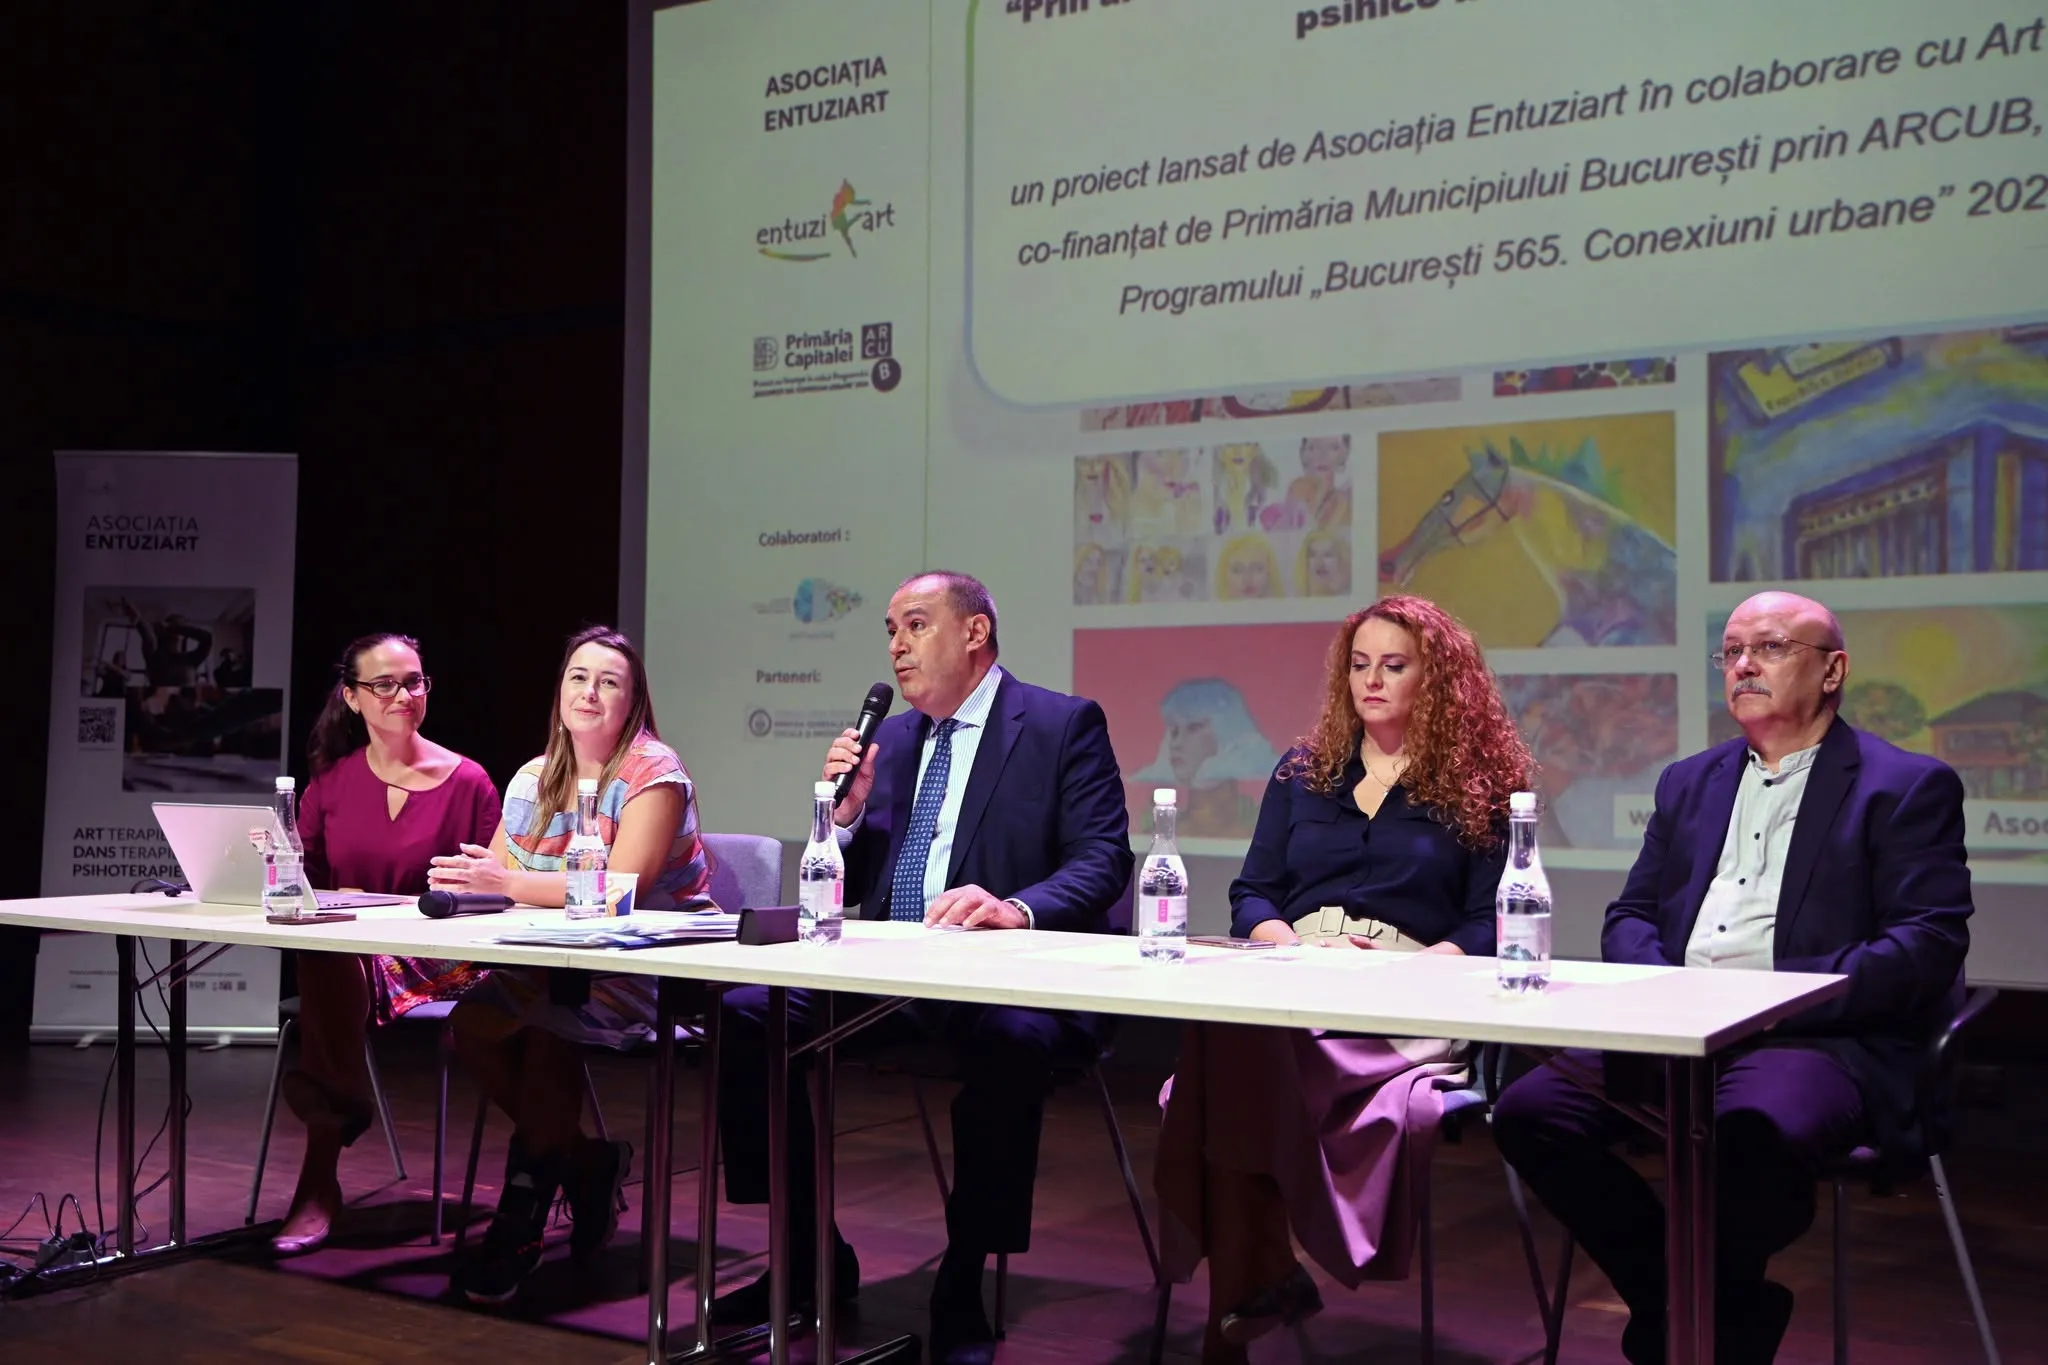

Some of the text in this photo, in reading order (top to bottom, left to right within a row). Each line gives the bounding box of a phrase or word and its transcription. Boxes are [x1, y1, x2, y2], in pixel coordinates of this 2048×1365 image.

[764, 56, 887, 98] ASOCIAȚIA
[763, 90, 889, 132] ENTUZIART
[1011, 17, 2046, 207] un proiect lansat de Asociația Entuziart în colaborare cu Art
[1018, 97, 2041, 266] co-finanțat de Primăria Municipiului București prin ARCUB,
[1120, 266, 1303, 315] Programului
[1494, 234, 1567, 272] 565.
[1584, 206, 1777, 261] Conexiuni
[786, 328, 853, 349] Primăria
[785, 346, 853, 370] Capitalei
[85, 534, 199, 551] ENTUZIART
[758, 529, 842, 546] Colaboratori
[73, 827, 105, 840] ART
[73, 846, 116, 859] DANS
[73, 864, 182, 878] PSIHOTERAPIE
